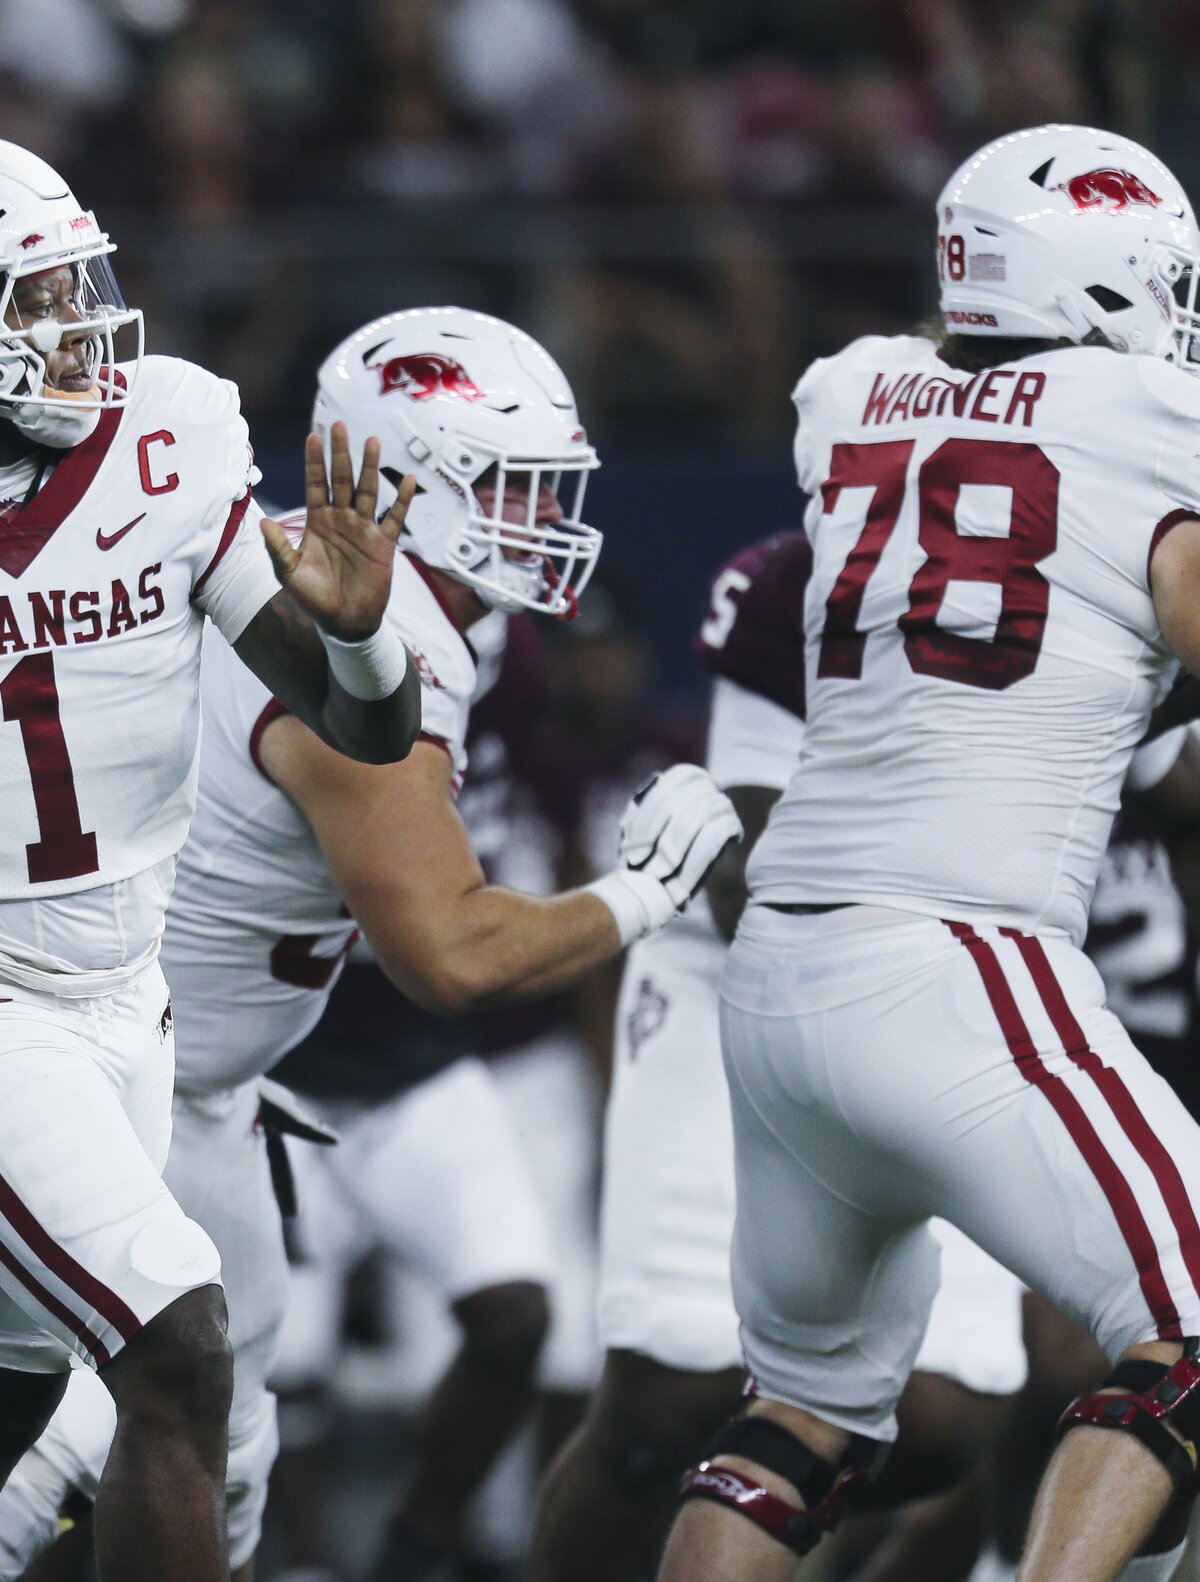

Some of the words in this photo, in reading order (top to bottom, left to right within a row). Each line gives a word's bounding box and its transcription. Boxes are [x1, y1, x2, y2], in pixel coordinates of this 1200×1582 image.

[137, 429, 180, 496] C
[861, 369, 1047, 427] WAGNER
[816, 437, 1061, 691] 78
[0, 650, 100, 885] 1
